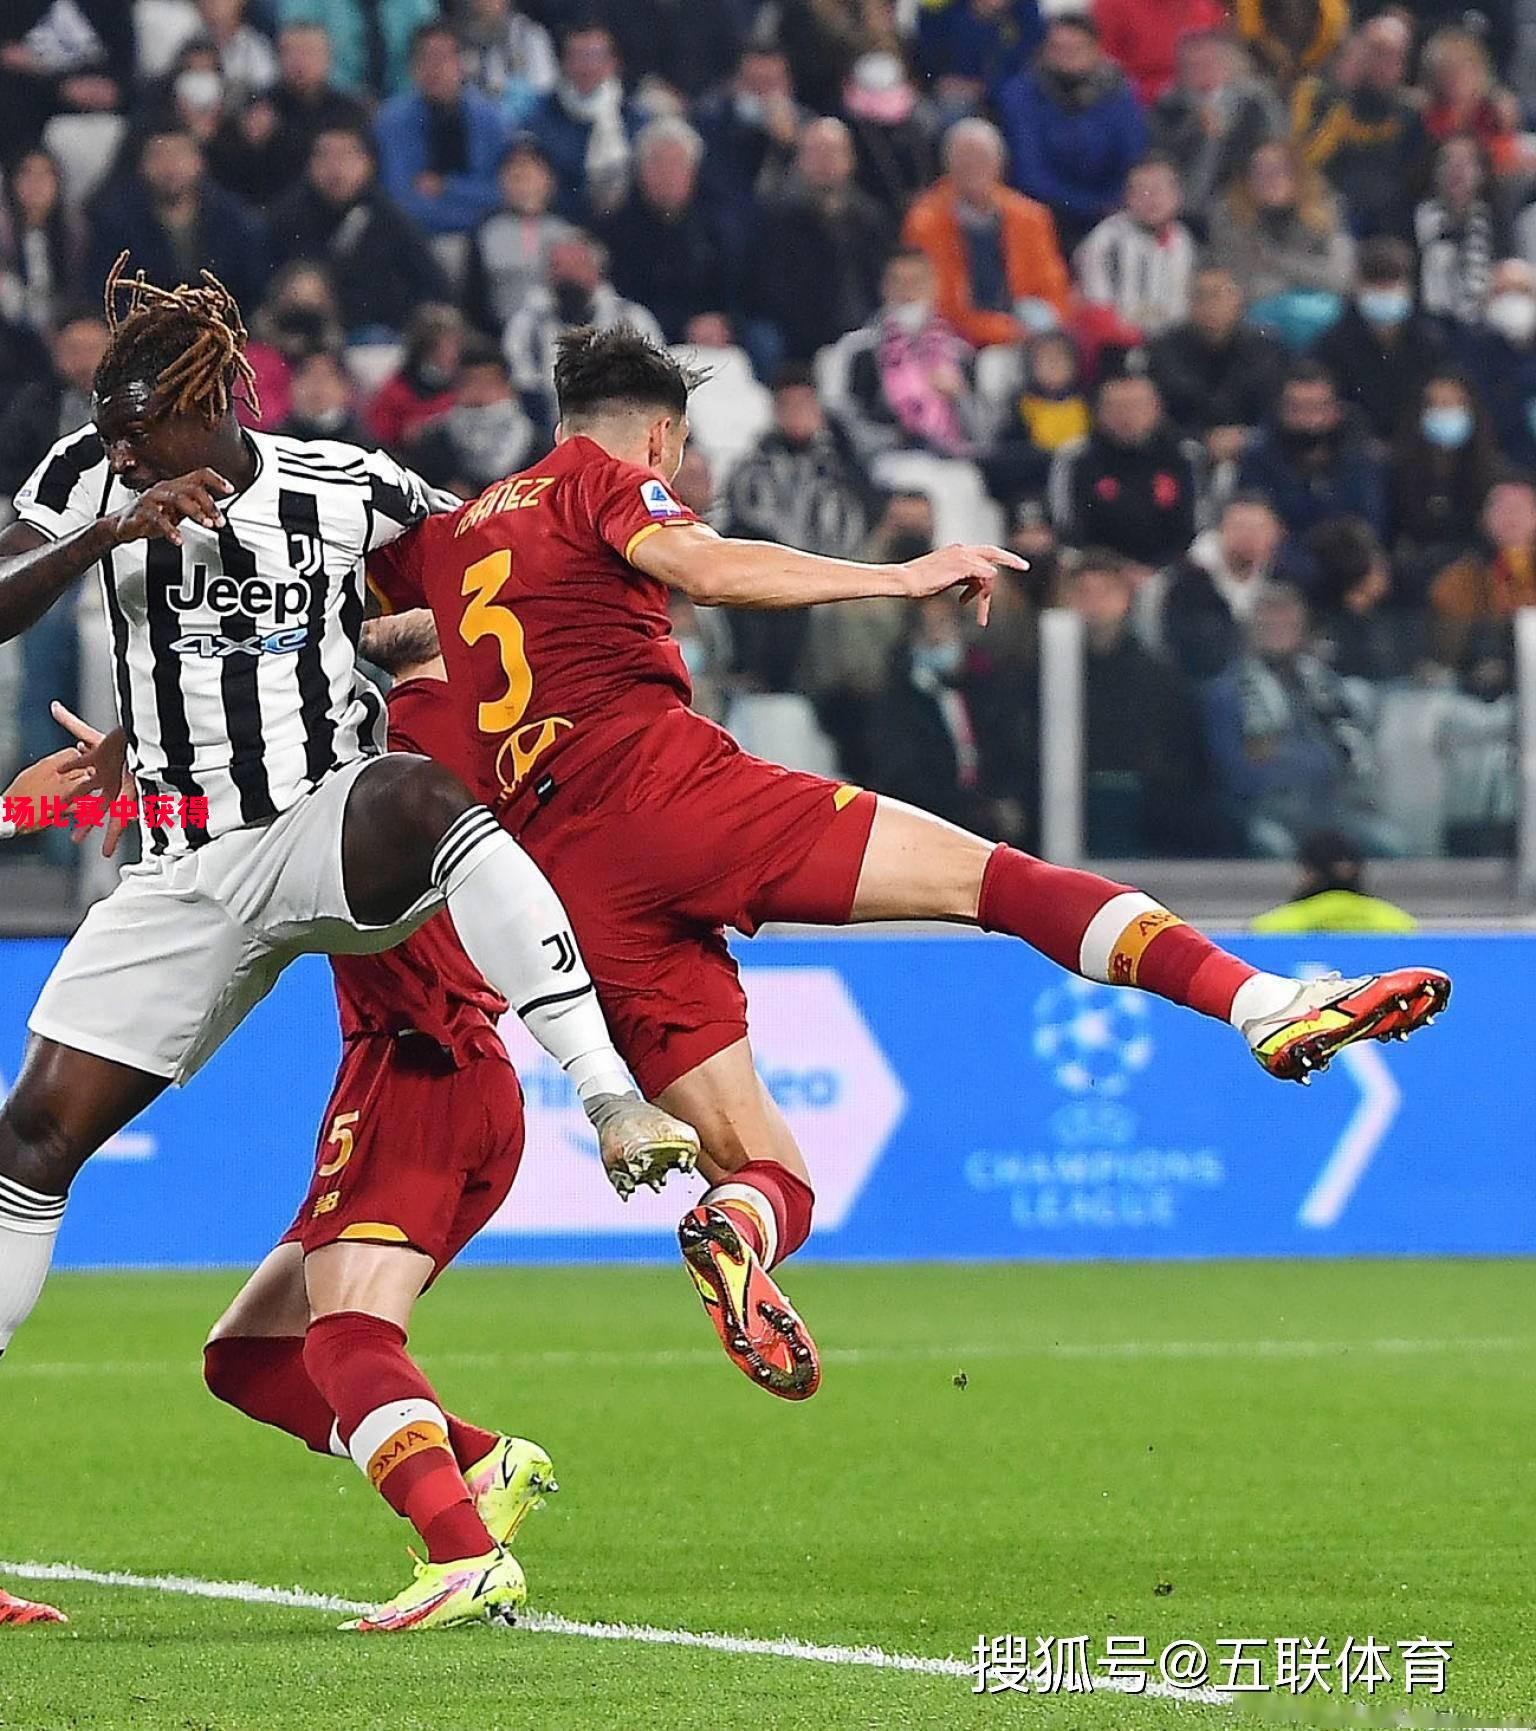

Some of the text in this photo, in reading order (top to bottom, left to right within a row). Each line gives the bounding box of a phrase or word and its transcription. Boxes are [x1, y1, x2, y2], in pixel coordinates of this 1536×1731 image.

[167, 563, 310, 625] Jeep
[459, 548, 533, 733] 3
[318, 1109, 360, 1177] 5
[372, 1431, 429, 1484] OMA
